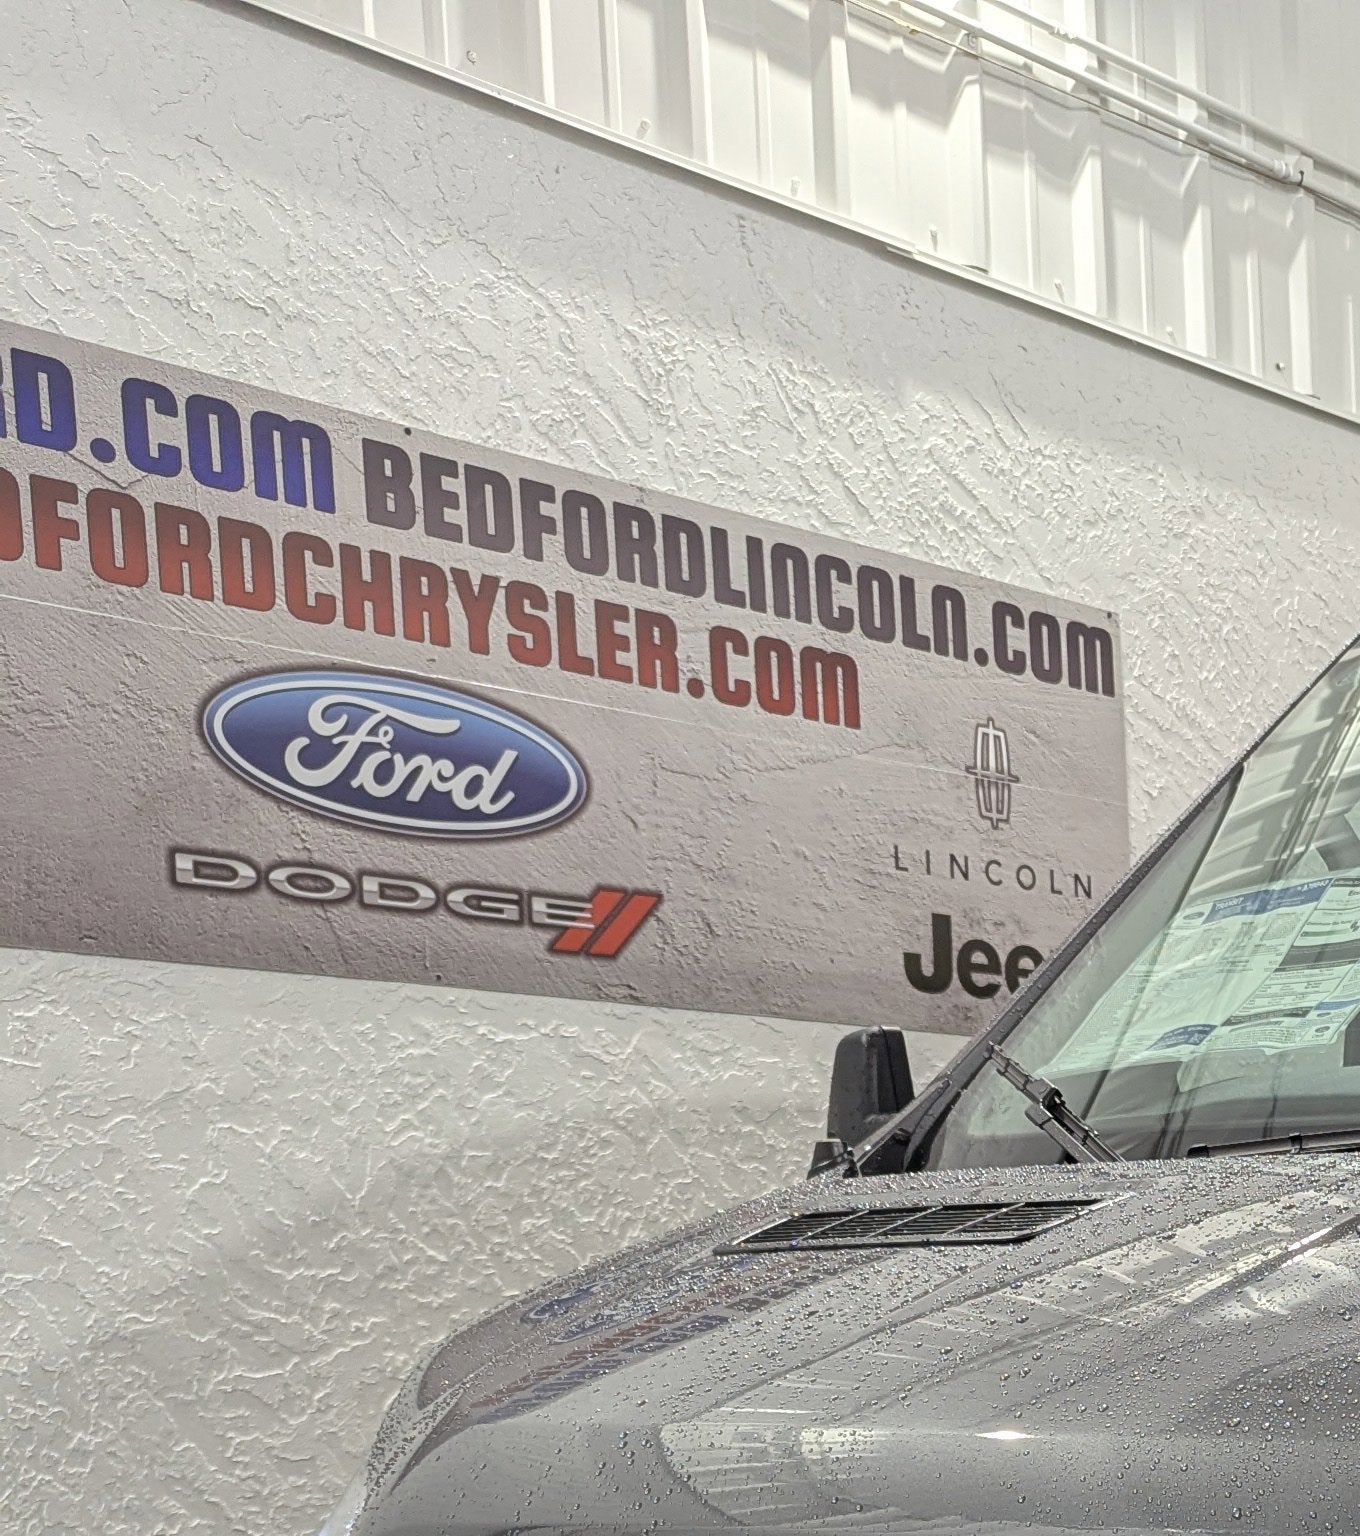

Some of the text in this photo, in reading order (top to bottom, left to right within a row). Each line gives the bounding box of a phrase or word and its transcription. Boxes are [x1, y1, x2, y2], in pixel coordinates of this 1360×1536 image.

[0, 347, 1115, 698] D.COM BEDFORDLINCOLN.COM
[284, 694, 519, 815] Ford
[172, 851, 597, 931] DODGE
[894, 845, 1092, 899] LINCOLN
